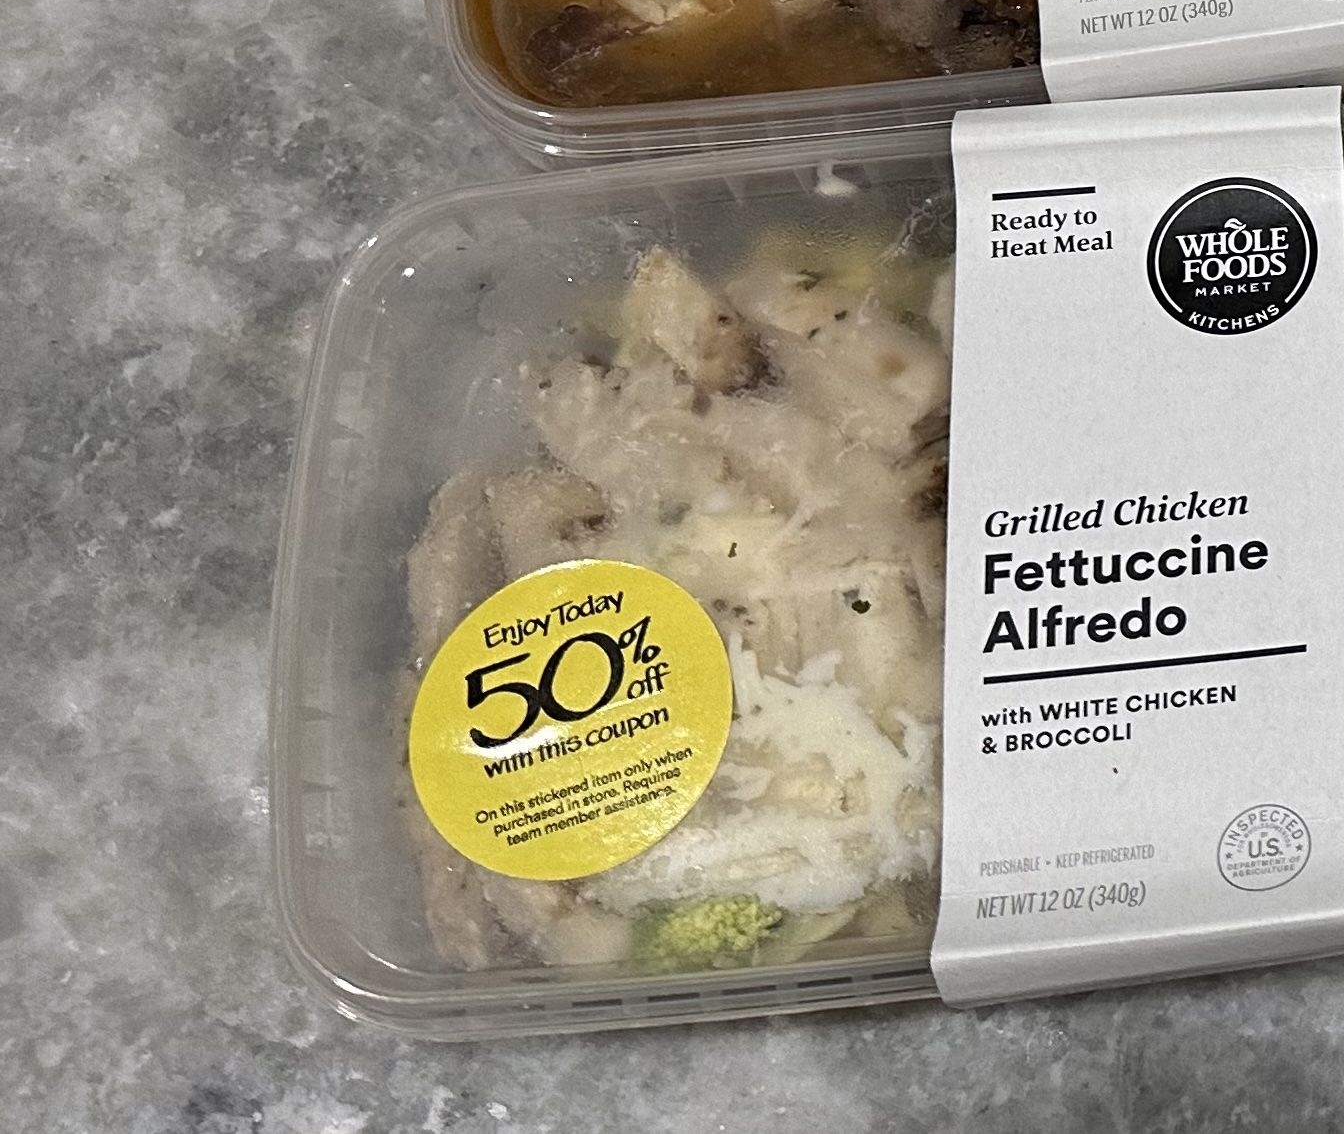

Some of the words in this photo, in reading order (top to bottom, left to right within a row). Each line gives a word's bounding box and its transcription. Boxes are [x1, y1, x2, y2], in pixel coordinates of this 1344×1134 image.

[1080, 16, 1107, 35] NET
[1111, 12, 1134, 31] WT
[1138, 9, 1155, 27] 12
[1158, 5, 1178, 23] OZ
[991, 210, 1068, 232] Ready
[1073, 210, 1097, 225] to
[990, 240, 1048, 258] Heat
[1054, 231, 1113, 254] Meal
[1175, 226, 1289, 258] WHOLE
[1182, 252, 1287, 284] FOODS
[1195, 282, 1271, 297] MARKET
[1188, 304, 1280, 330] KITCHENS
[985, 500, 1105, 537] Grilled
[1114, 491, 1249, 526] Chicken
[984, 534, 1269, 595] Fettuccine
[483, 615, 550, 649] Enjoy
[550, 592, 624, 626] Today
[983, 597, 1188, 653] Alfredo
[465, 616, 662, 749] 50%
[627, 662, 671, 700] off
[981, 707, 1032, 727] with
[1040, 698, 1118, 721] WHITE
[1126, 685, 1237, 713] CHICKEN
[539, 734, 583, 763] this
[586, 707, 670, 747] coupon
[981, 737, 998, 754] &
[1005, 723, 1131, 753] BROCCOLI
[976, 895, 1007, 919] NET
[1010, 894, 1035, 915] WT
[1039, 890, 1058, 912] 12
[1063, 887, 1084, 910] OZ
[1088, 881, 1146, 911] (340g)
